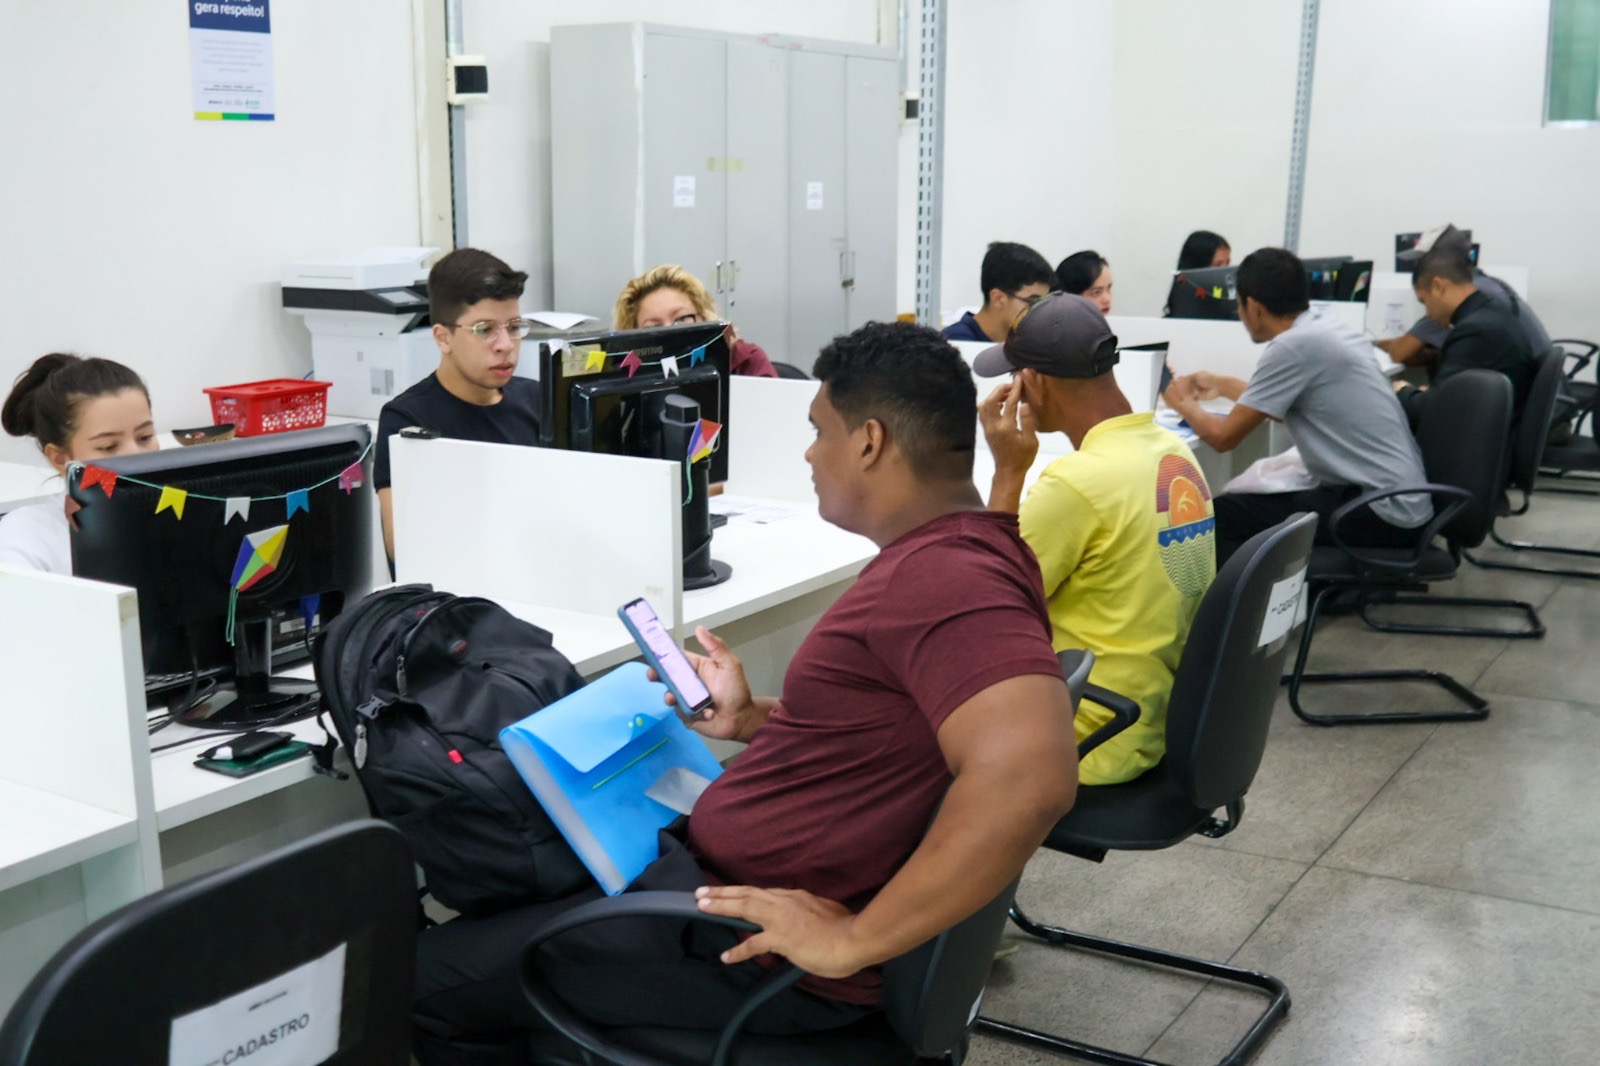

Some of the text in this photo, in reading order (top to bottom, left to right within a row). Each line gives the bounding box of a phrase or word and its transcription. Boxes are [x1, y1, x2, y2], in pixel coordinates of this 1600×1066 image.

[194, 2, 265, 18] gera respeito!
[222, 1013, 310, 1065] CADASTRO
